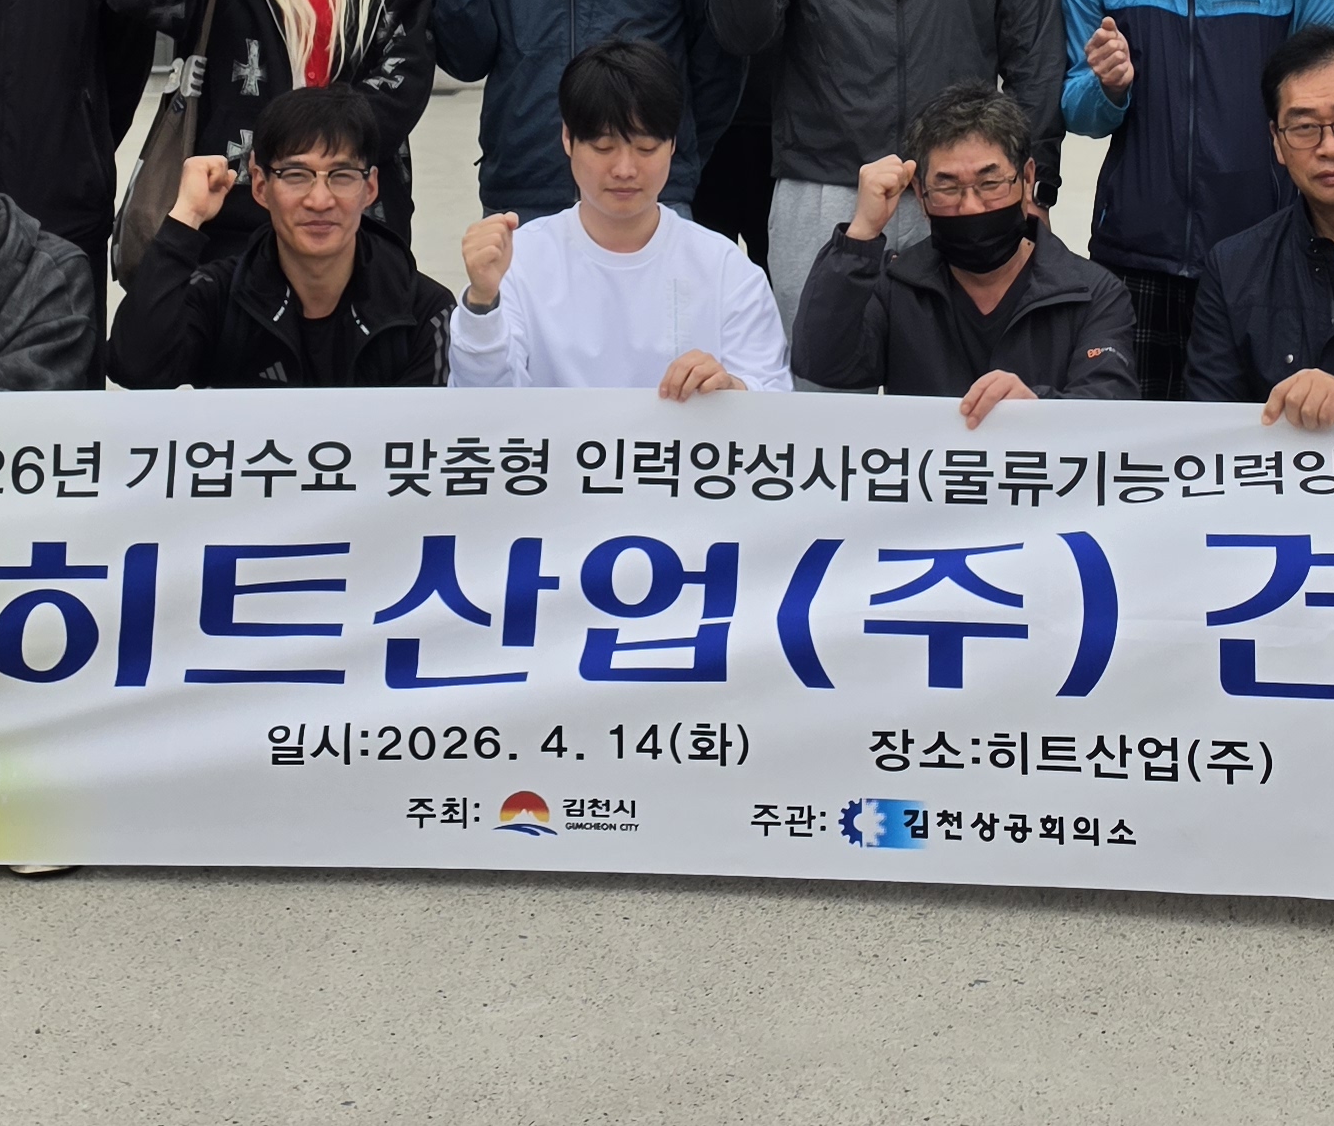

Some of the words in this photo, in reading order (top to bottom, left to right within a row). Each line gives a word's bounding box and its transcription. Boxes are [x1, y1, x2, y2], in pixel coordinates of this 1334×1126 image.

[125, 439, 357, 499] 기업수요
[384, 437, 551, 498] 맞춤형
[868, 728, 1274, 786] 장소:히트산업(주)
[405, 796, 482, 830] 주최:
[562, 798, 636, 819] 김천시
[565, 822, 617, 831] GIMCHEON
[620, 823, 640, 832] CITY
[750, 803, 827, 839] 주관:
[903, 807, 1139, 846] 김천상공회의소
